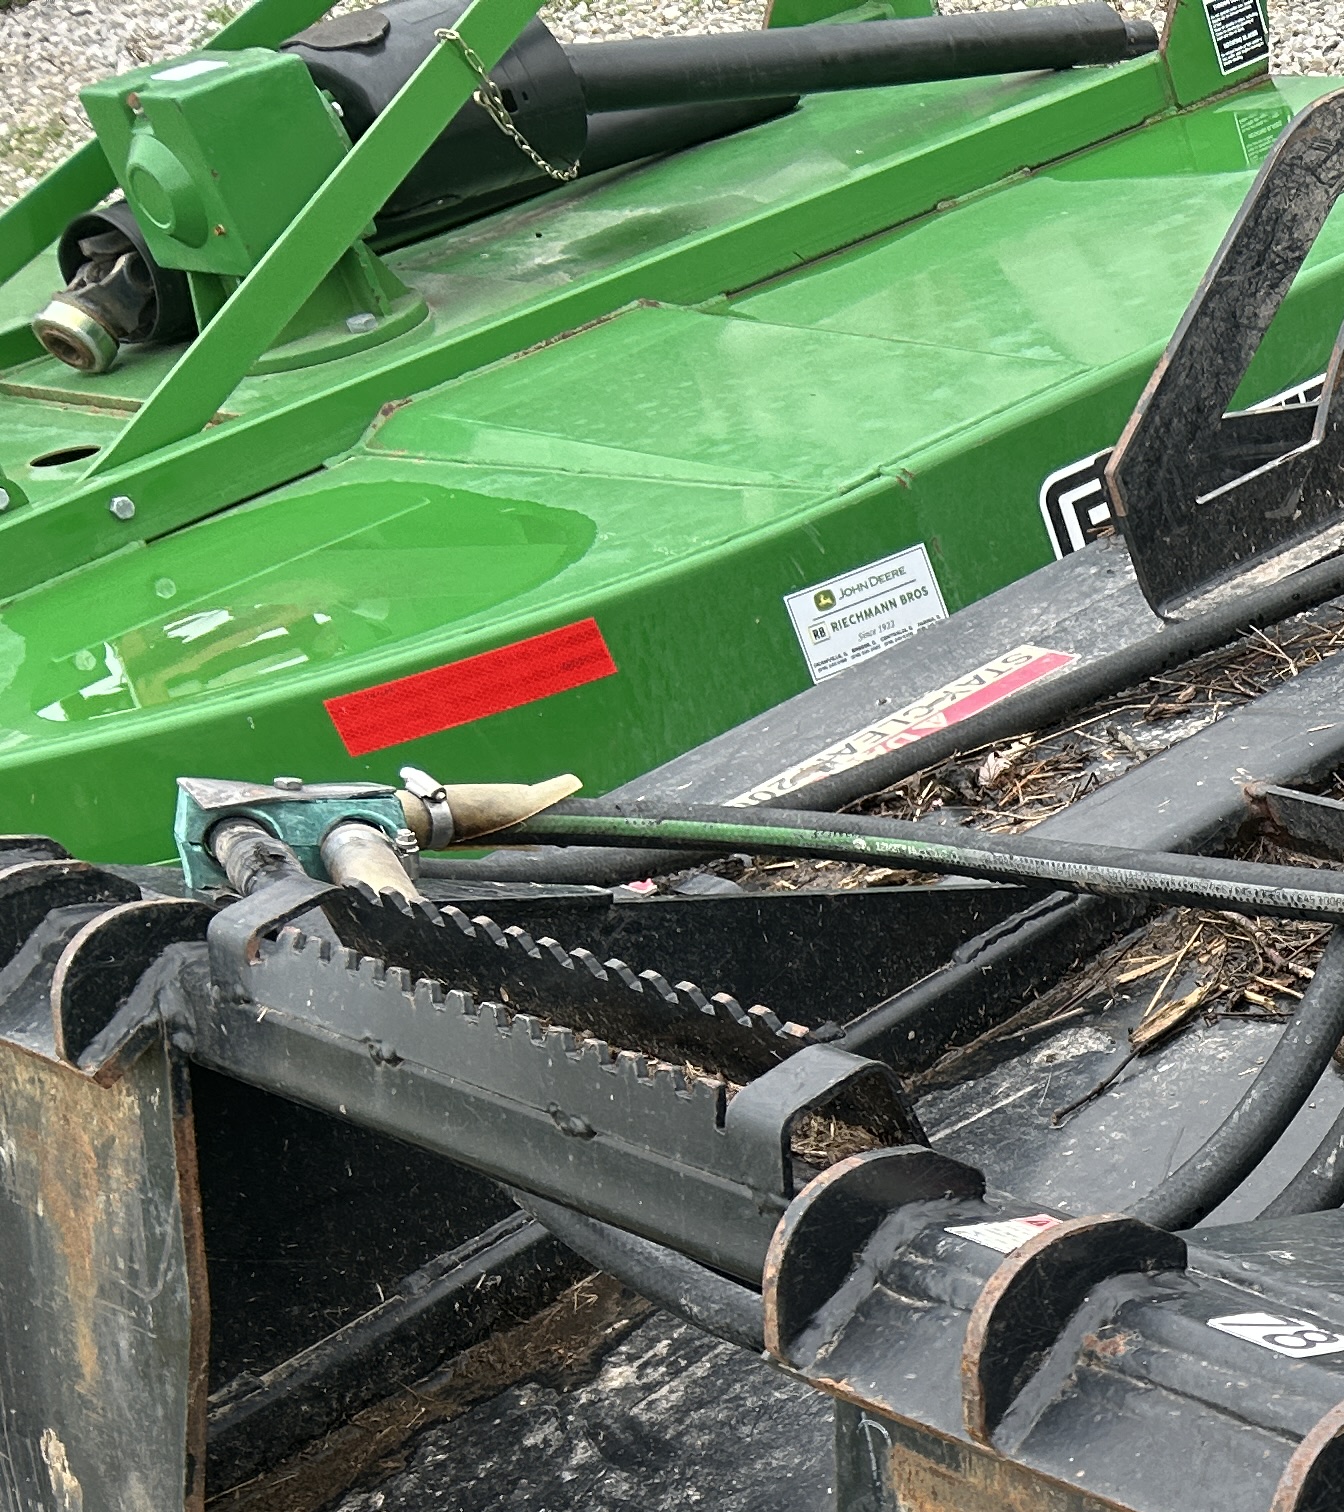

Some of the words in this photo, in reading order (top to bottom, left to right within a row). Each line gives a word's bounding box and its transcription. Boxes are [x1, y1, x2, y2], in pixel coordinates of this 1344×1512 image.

[839, 581, 869, 601] JOHN
[868, 565, 907, 588] DEERE
[830, 597, 898, 633] RIECHMANN
[900, 585, 930, 606] BROS
[812, 626, 827, 641] RB
